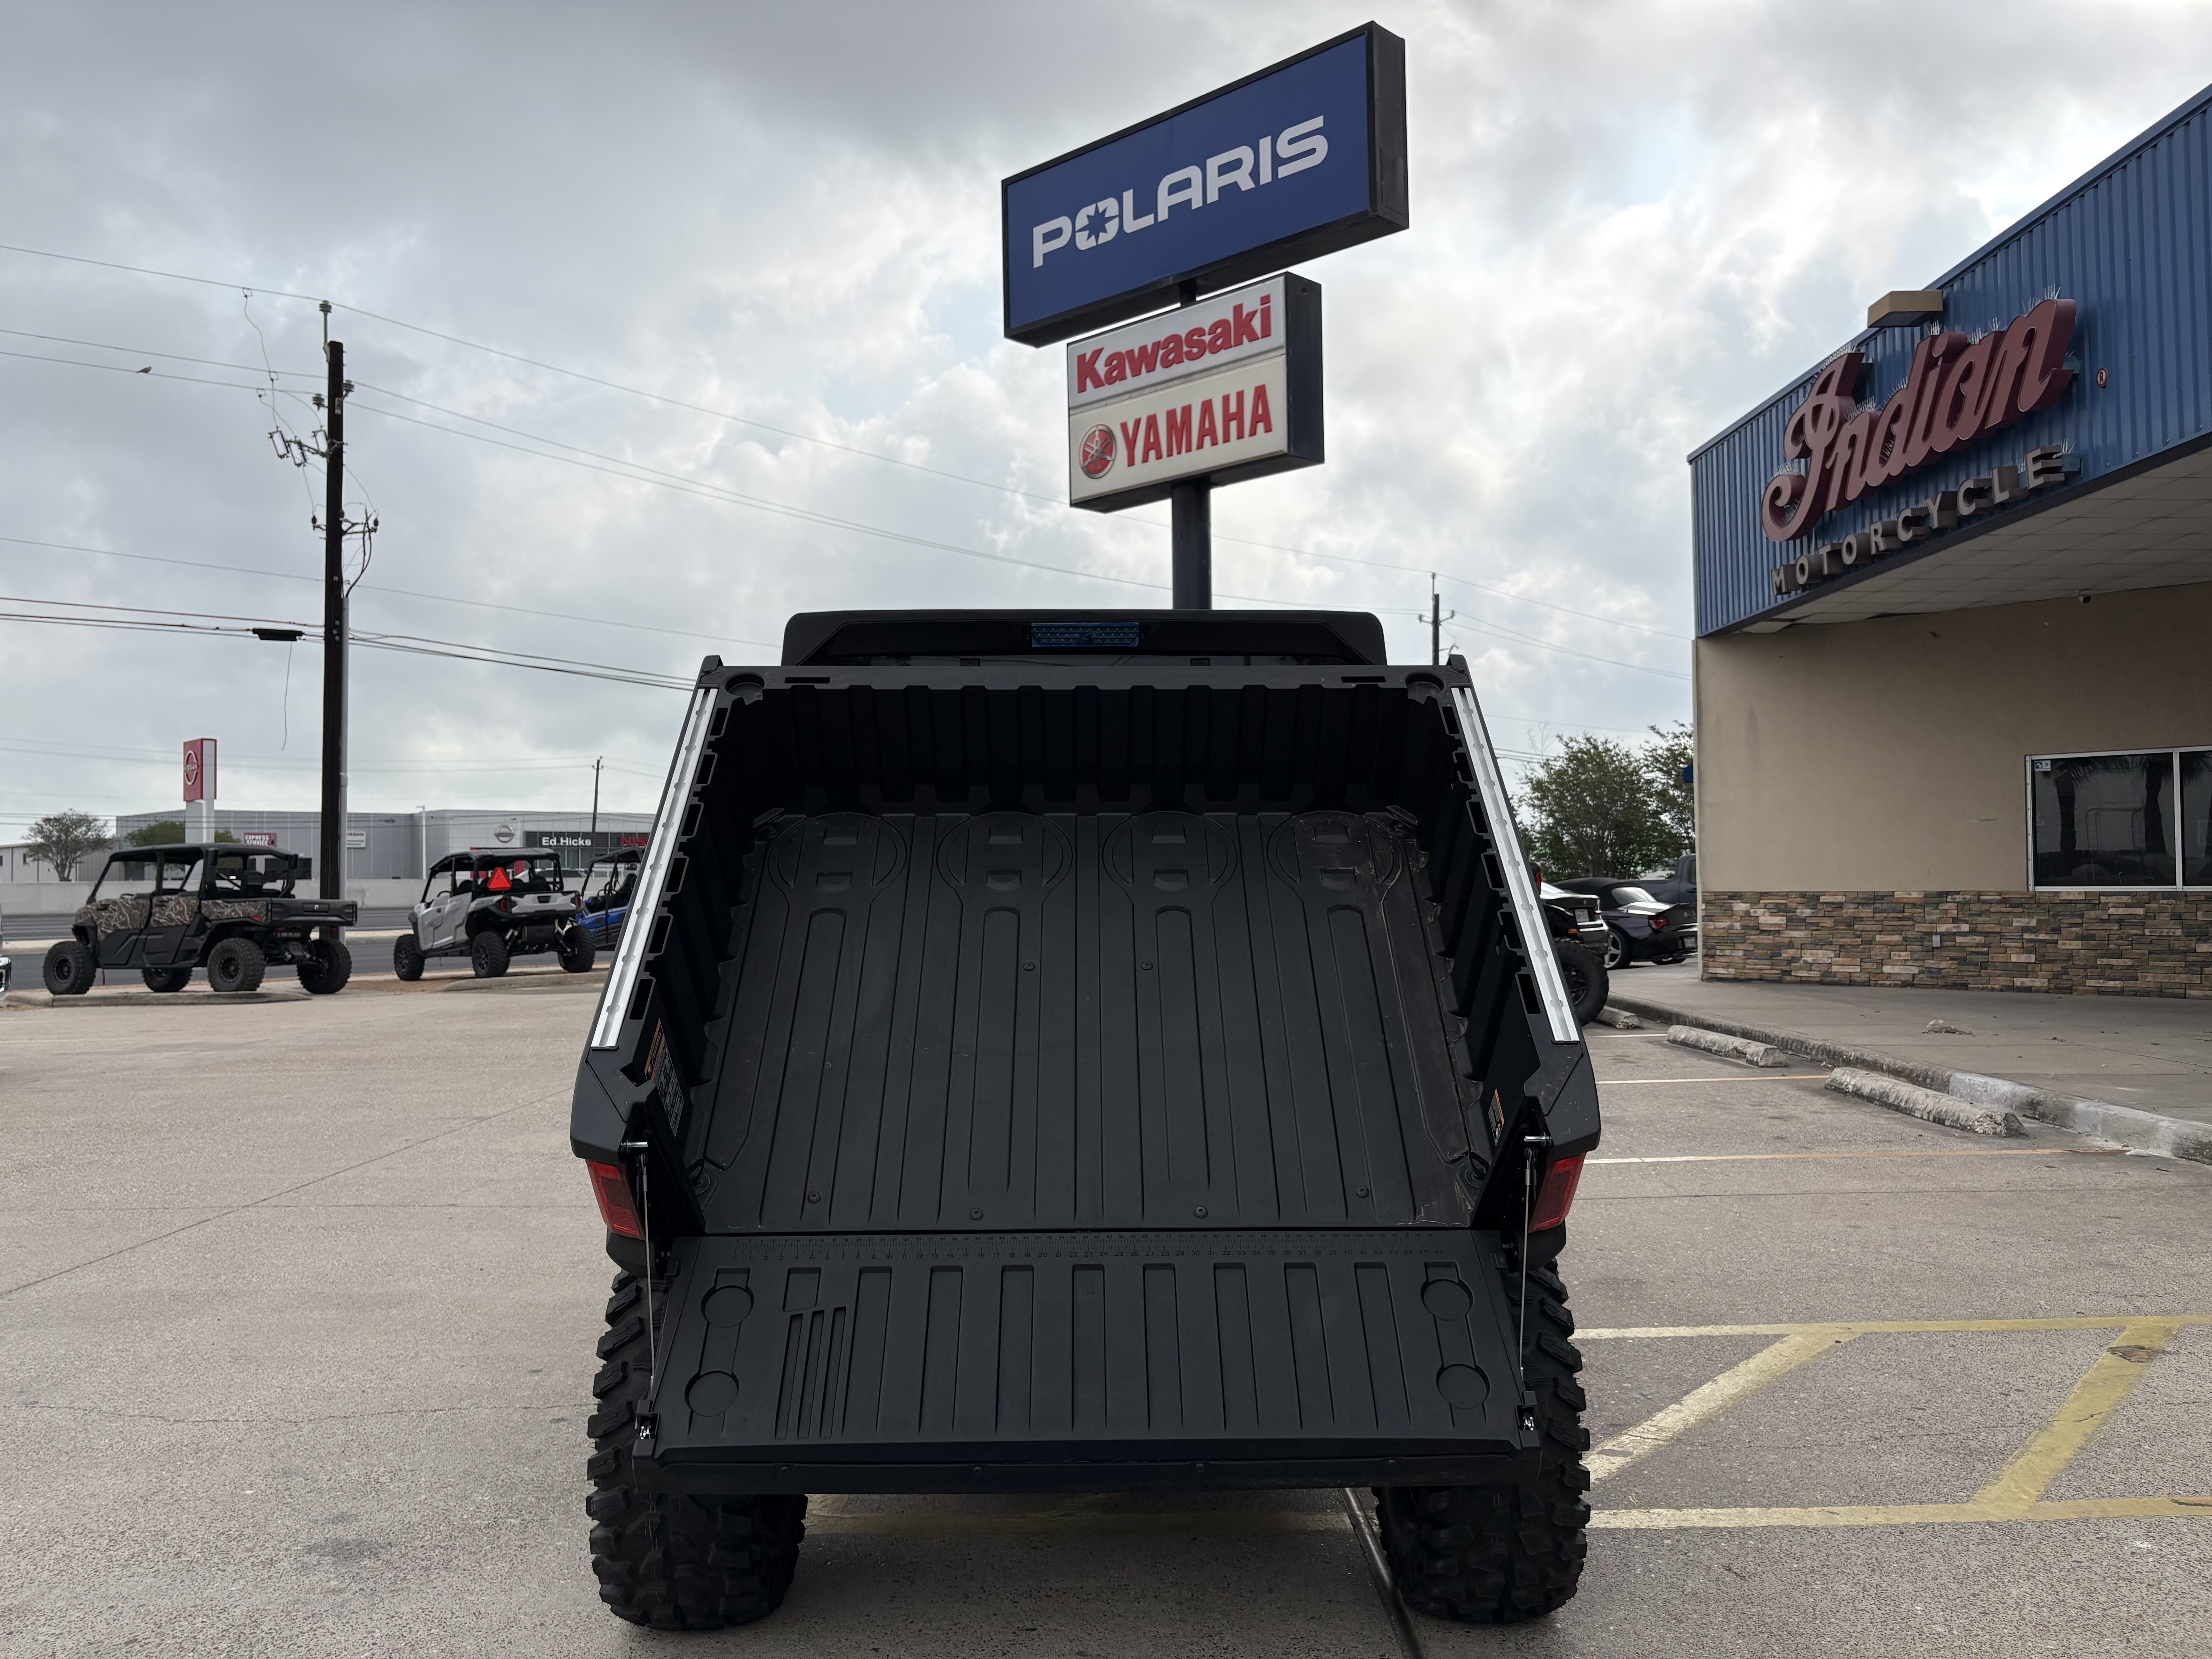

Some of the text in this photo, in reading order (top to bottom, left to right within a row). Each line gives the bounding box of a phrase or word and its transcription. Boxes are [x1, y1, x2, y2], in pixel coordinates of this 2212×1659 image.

[1032, 115, 1329, 269] POLARIS
[1077, 294, 1272, 394] Kawasaki
[1120, 384, 1273, 467] YAMAHA
[1761, 299, 2077, 541] Indian
[1771, 445, 2064, 595] MOTORCYCLE
[542, 836, 650, 846] Ed Hicks NIS
